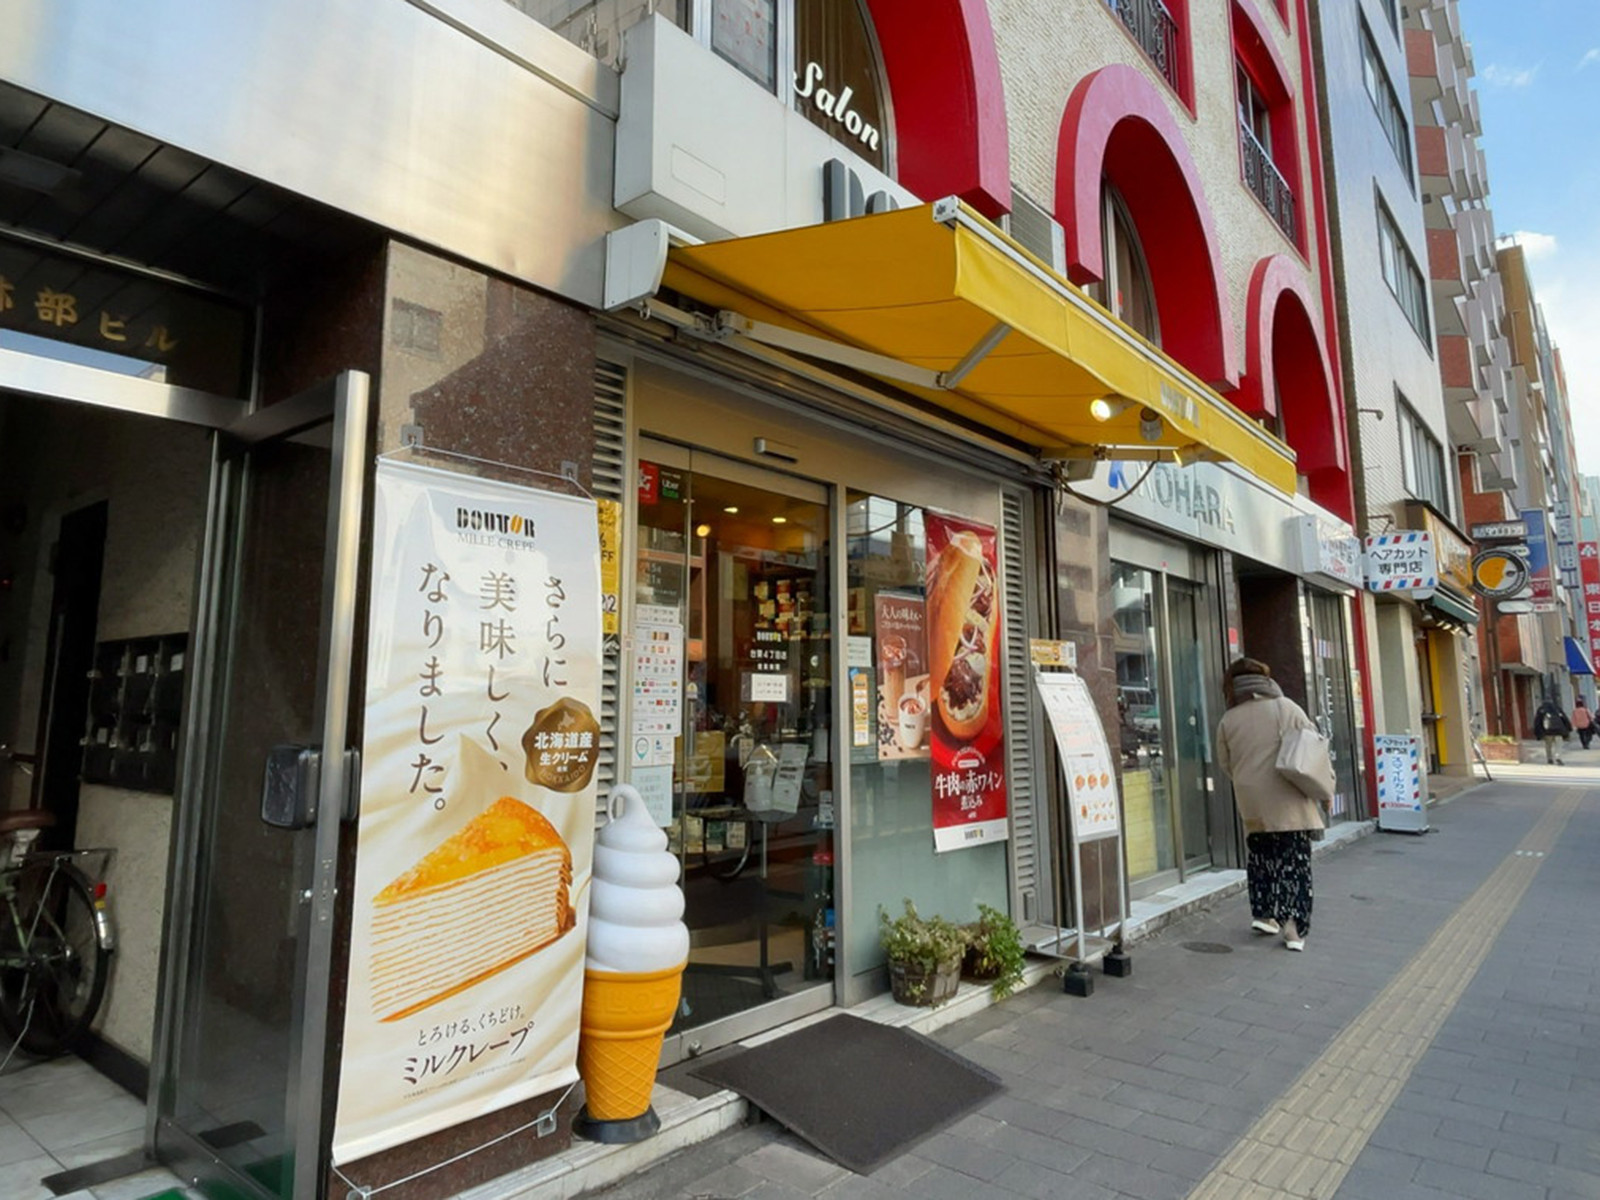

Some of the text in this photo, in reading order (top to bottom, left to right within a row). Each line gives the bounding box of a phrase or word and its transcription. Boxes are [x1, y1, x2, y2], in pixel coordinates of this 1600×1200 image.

[793, 61, 879, 151] Salon
[457, 507, 535, 538] DOUTOR
[1370, 546, 1428, 561] ヘアカット
[1378, 560, 1423, 575] 専門店
[543, 576, 567, 687] さらに
[410, 563, 451, 811] なりました。
[480, 570, 516, 771] 美味しく、
[534, 731, 593, 750] 北海道産
[403, 1020, 535, 1085] ミルクレープ
